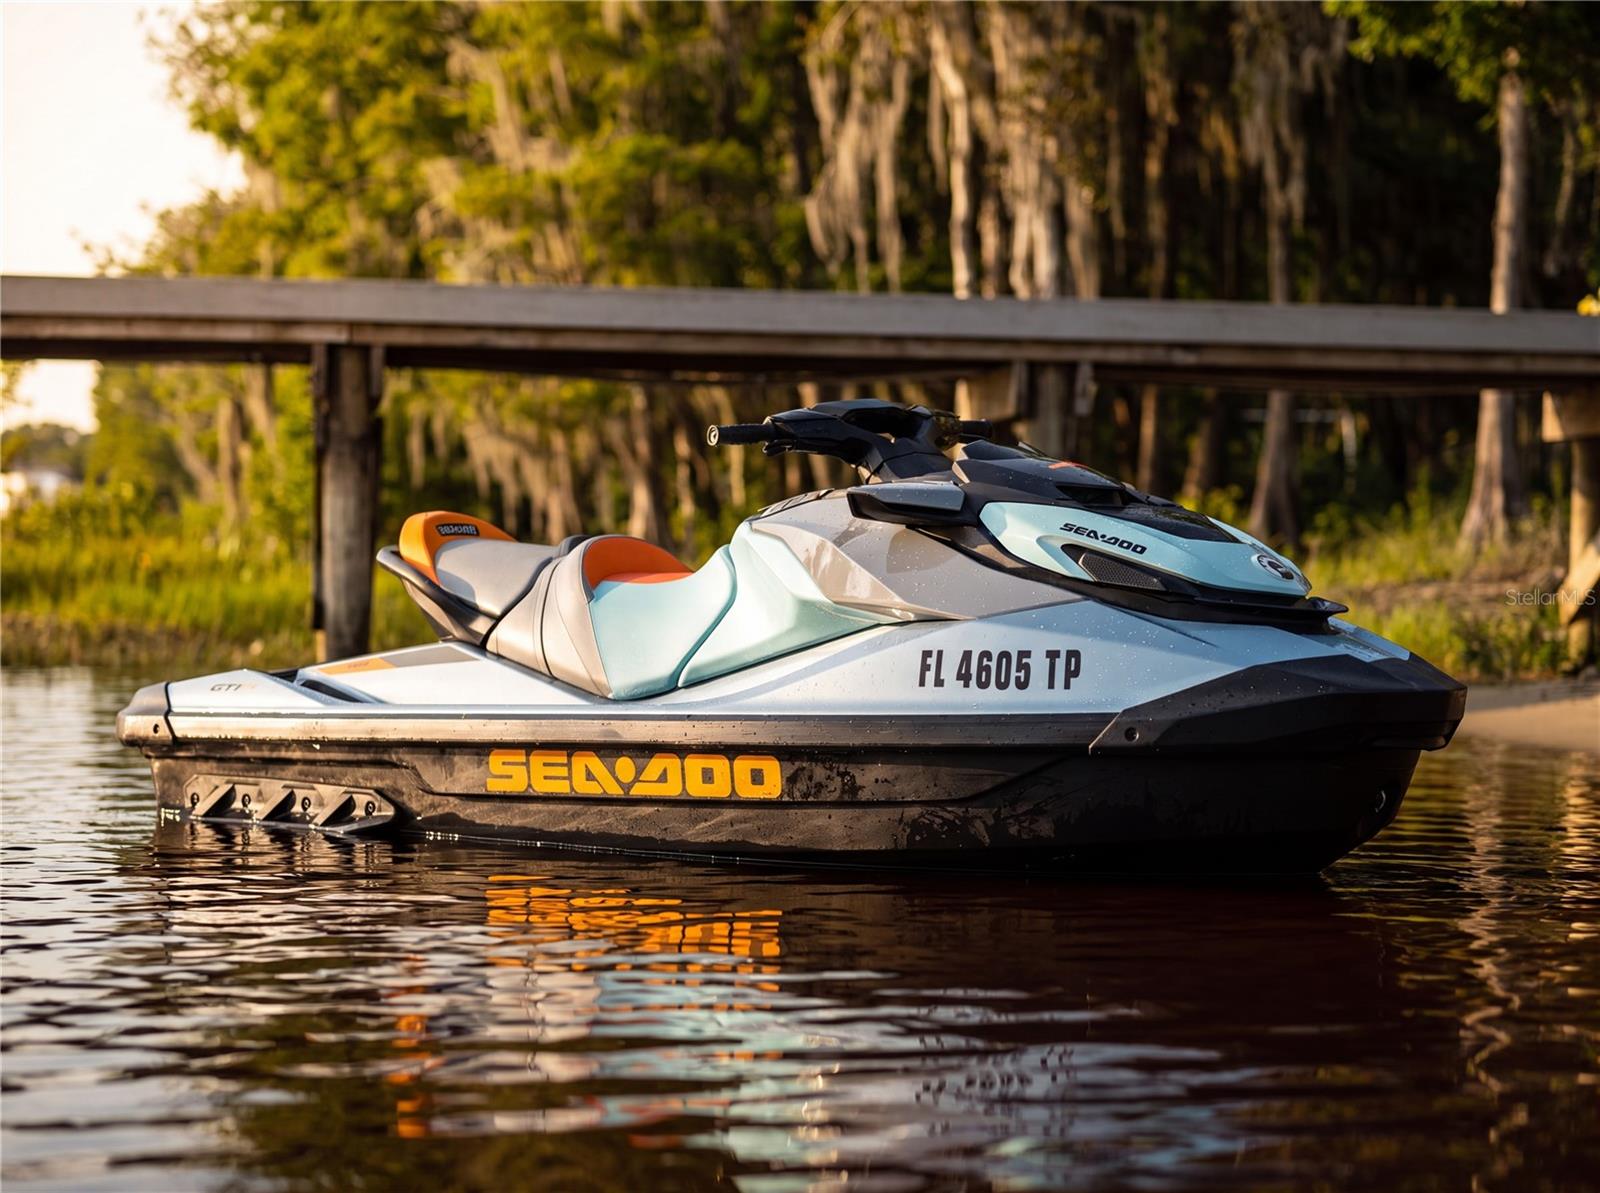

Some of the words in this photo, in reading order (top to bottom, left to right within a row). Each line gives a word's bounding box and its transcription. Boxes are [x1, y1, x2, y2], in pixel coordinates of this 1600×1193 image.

[918, 649, 945, 688] FL
[955, 649, 1032, 691] 4605
[1045, 649, 1082, 690] TP
